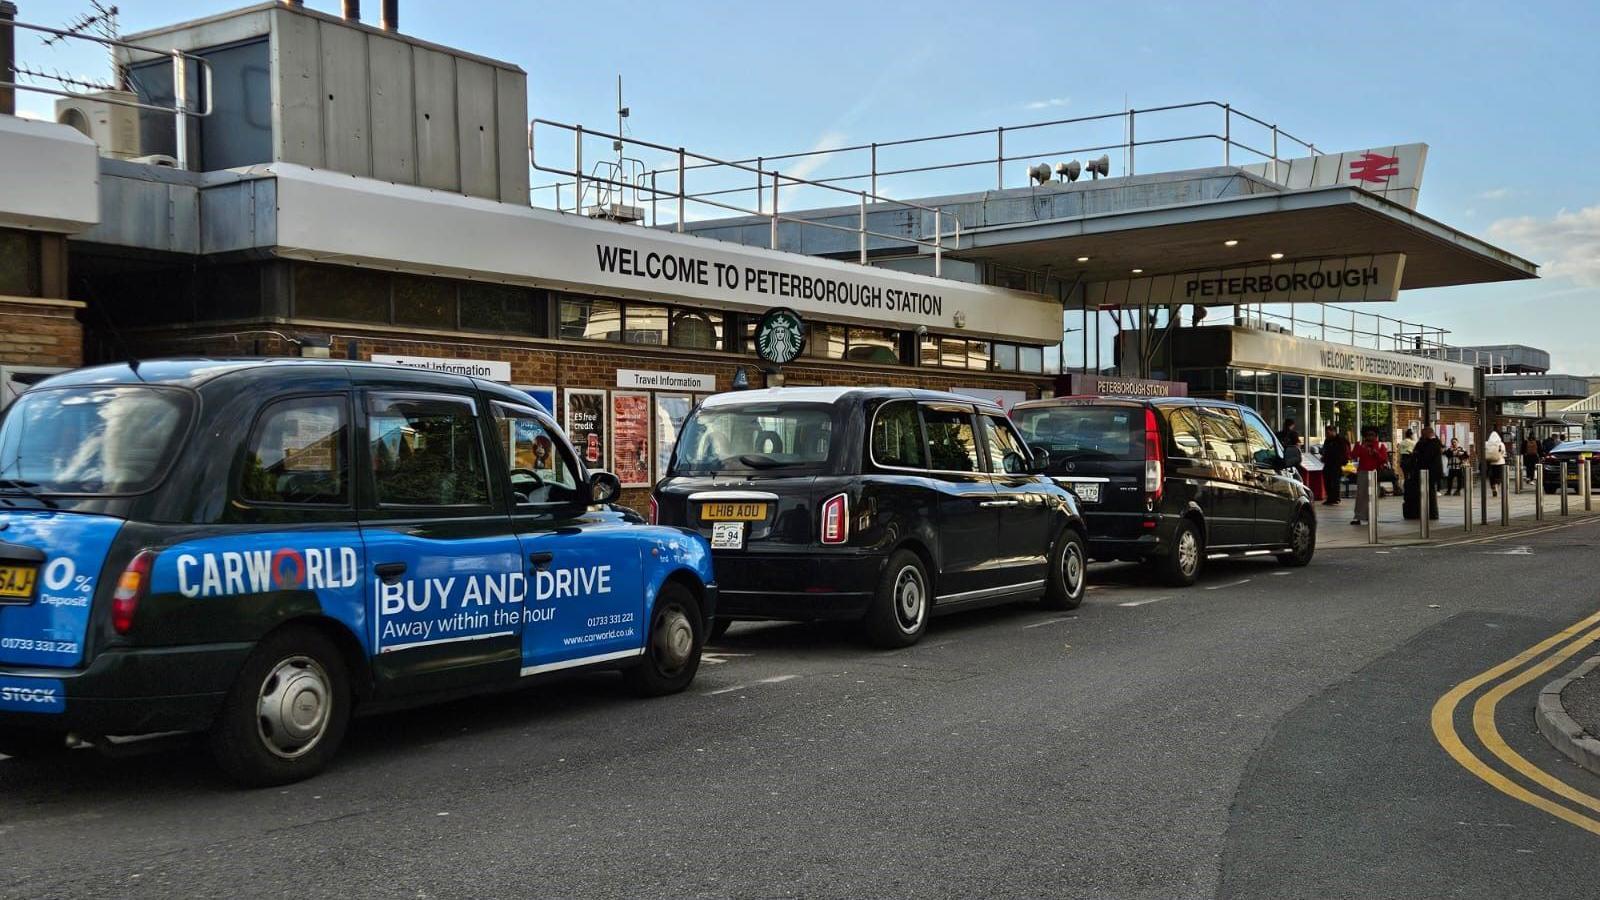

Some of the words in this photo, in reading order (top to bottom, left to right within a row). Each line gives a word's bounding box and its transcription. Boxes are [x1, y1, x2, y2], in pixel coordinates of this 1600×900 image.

[596, 244, 709, 286] WELCOME
[713, 262, 739, 290] TO
[745, 267, 882, 310] PETERBOROUGH
[885, 288, 942, 317] STATION
[1186, 267, 1378, 298] PETERBOROUGH
[1319, 349, 1355, 371] WELCOME
[1356, 355, 1365, 372] TO
[1366, 356, 1413, 379] PETERBOROUGH
[1413, 363, 1434, 380] STATION
[634, 373, 658, 385] Travel
[660, 375, 701, 387] Information
[1097, 380, 1146, 396] PETERBOROUGH
[1147, 384, 1169, 397] STATION
[583, 412, 597, 421] free
[574, 421, 594, 430] credit
[709, 504, 733, 517] LH18
[727, 531, 739, 541] 94
[176, 547, 358, 599] CARWORLD
[381, 576, 456, 616] BUY
[461, 572, 528, 608] AND
[536, 565, 612, 601] DRIVE
[40, 593, 88, 607] Deposit
[382, 619, 434, 640] Away
[437, 610, 490, 632] within
[494, 606, 519, 627] the
[522, 606, 556, 624] hour
[587, 616, 608, 628] 01733
[609, 614, 621, 625] 331
[622, 612, 634, 623] 221
[563, 626, 635, 646] www.carworld.co.uk
[1, 637, 34, 650] 01733
[35, 640, 55, 652] 331
[56, 642, 78, 654] 221
[2, 687, 57, 704] STOCK
